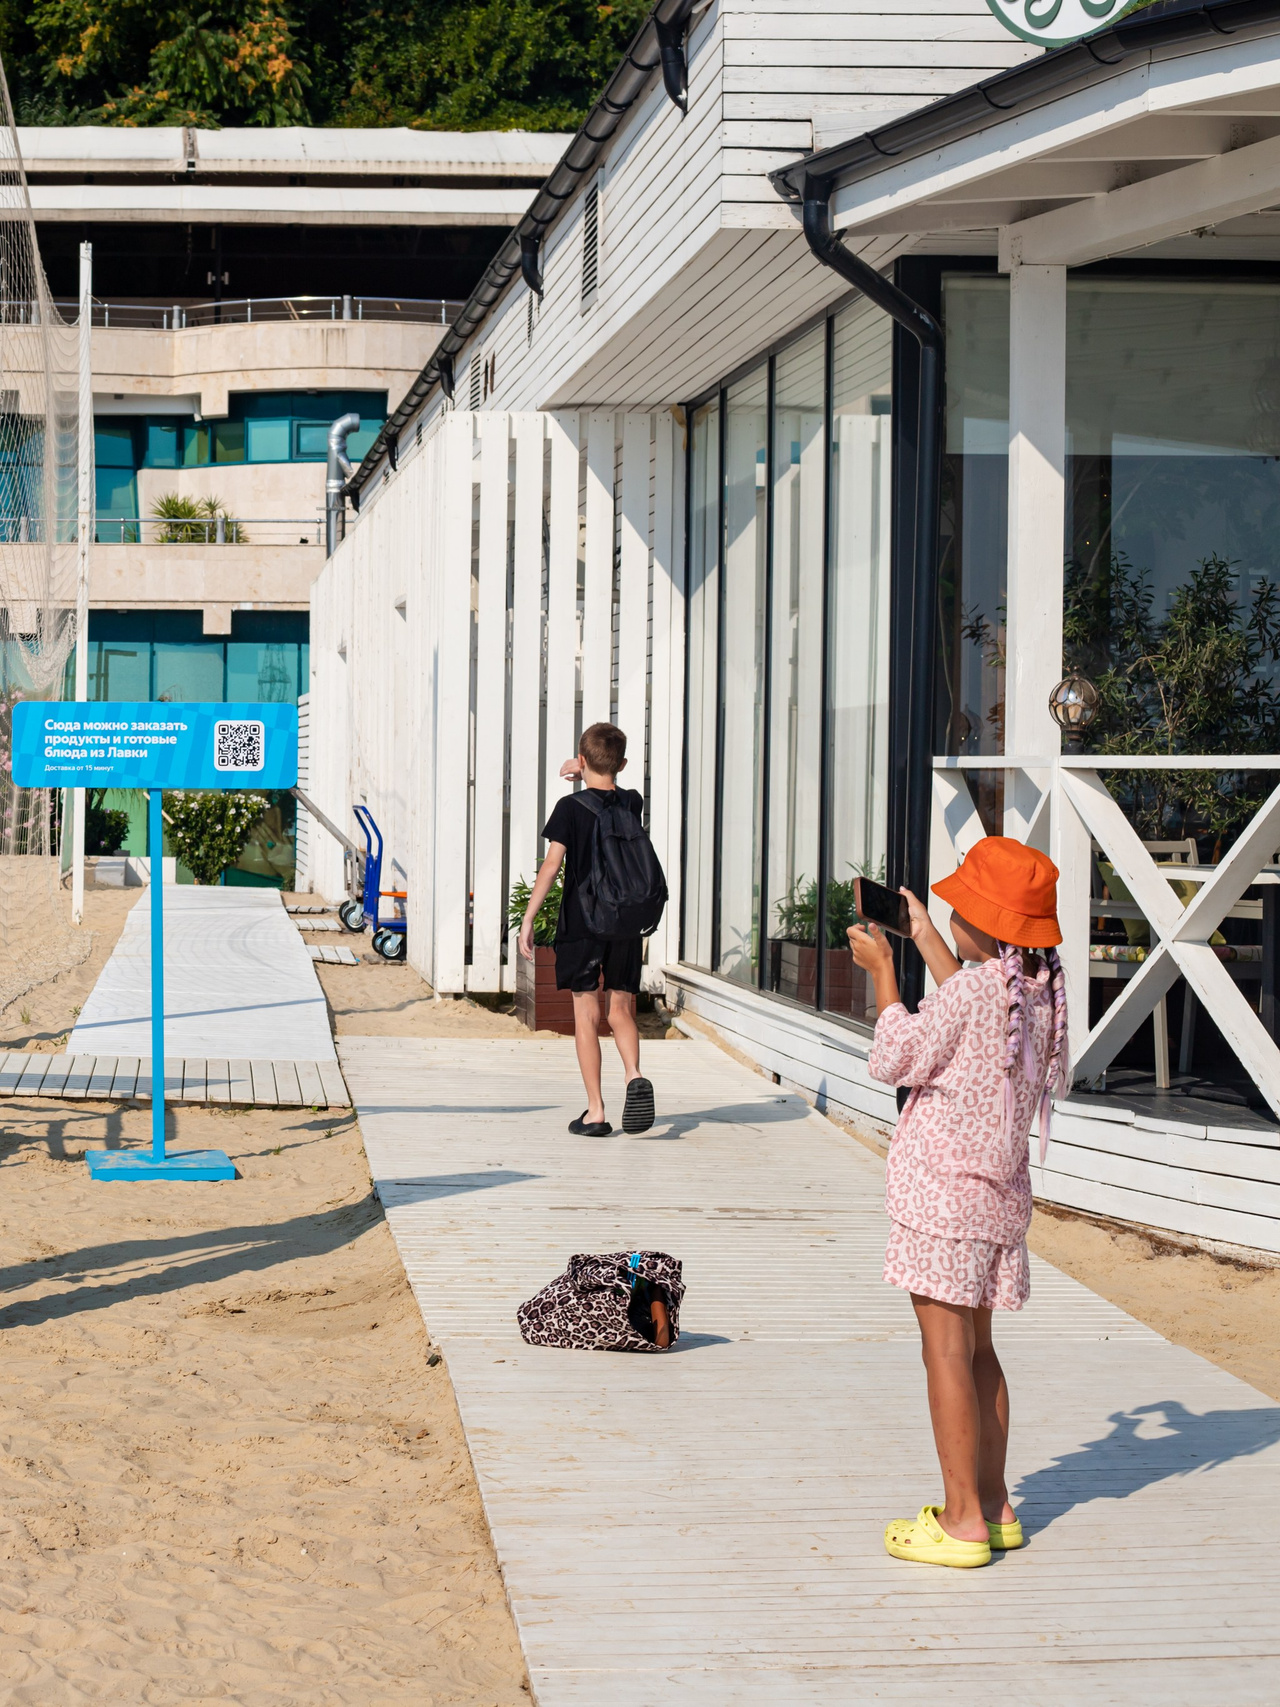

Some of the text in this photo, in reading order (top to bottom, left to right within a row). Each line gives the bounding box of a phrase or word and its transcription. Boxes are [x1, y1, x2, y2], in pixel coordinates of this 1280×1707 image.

[44, 719, 188, 733] Сюда можно заказать
[44, 734, 177, 746] продукты и готовые
[44, 747, 148, 760] блюда из Лавки
[44, 764, 75, 772] Доставка
